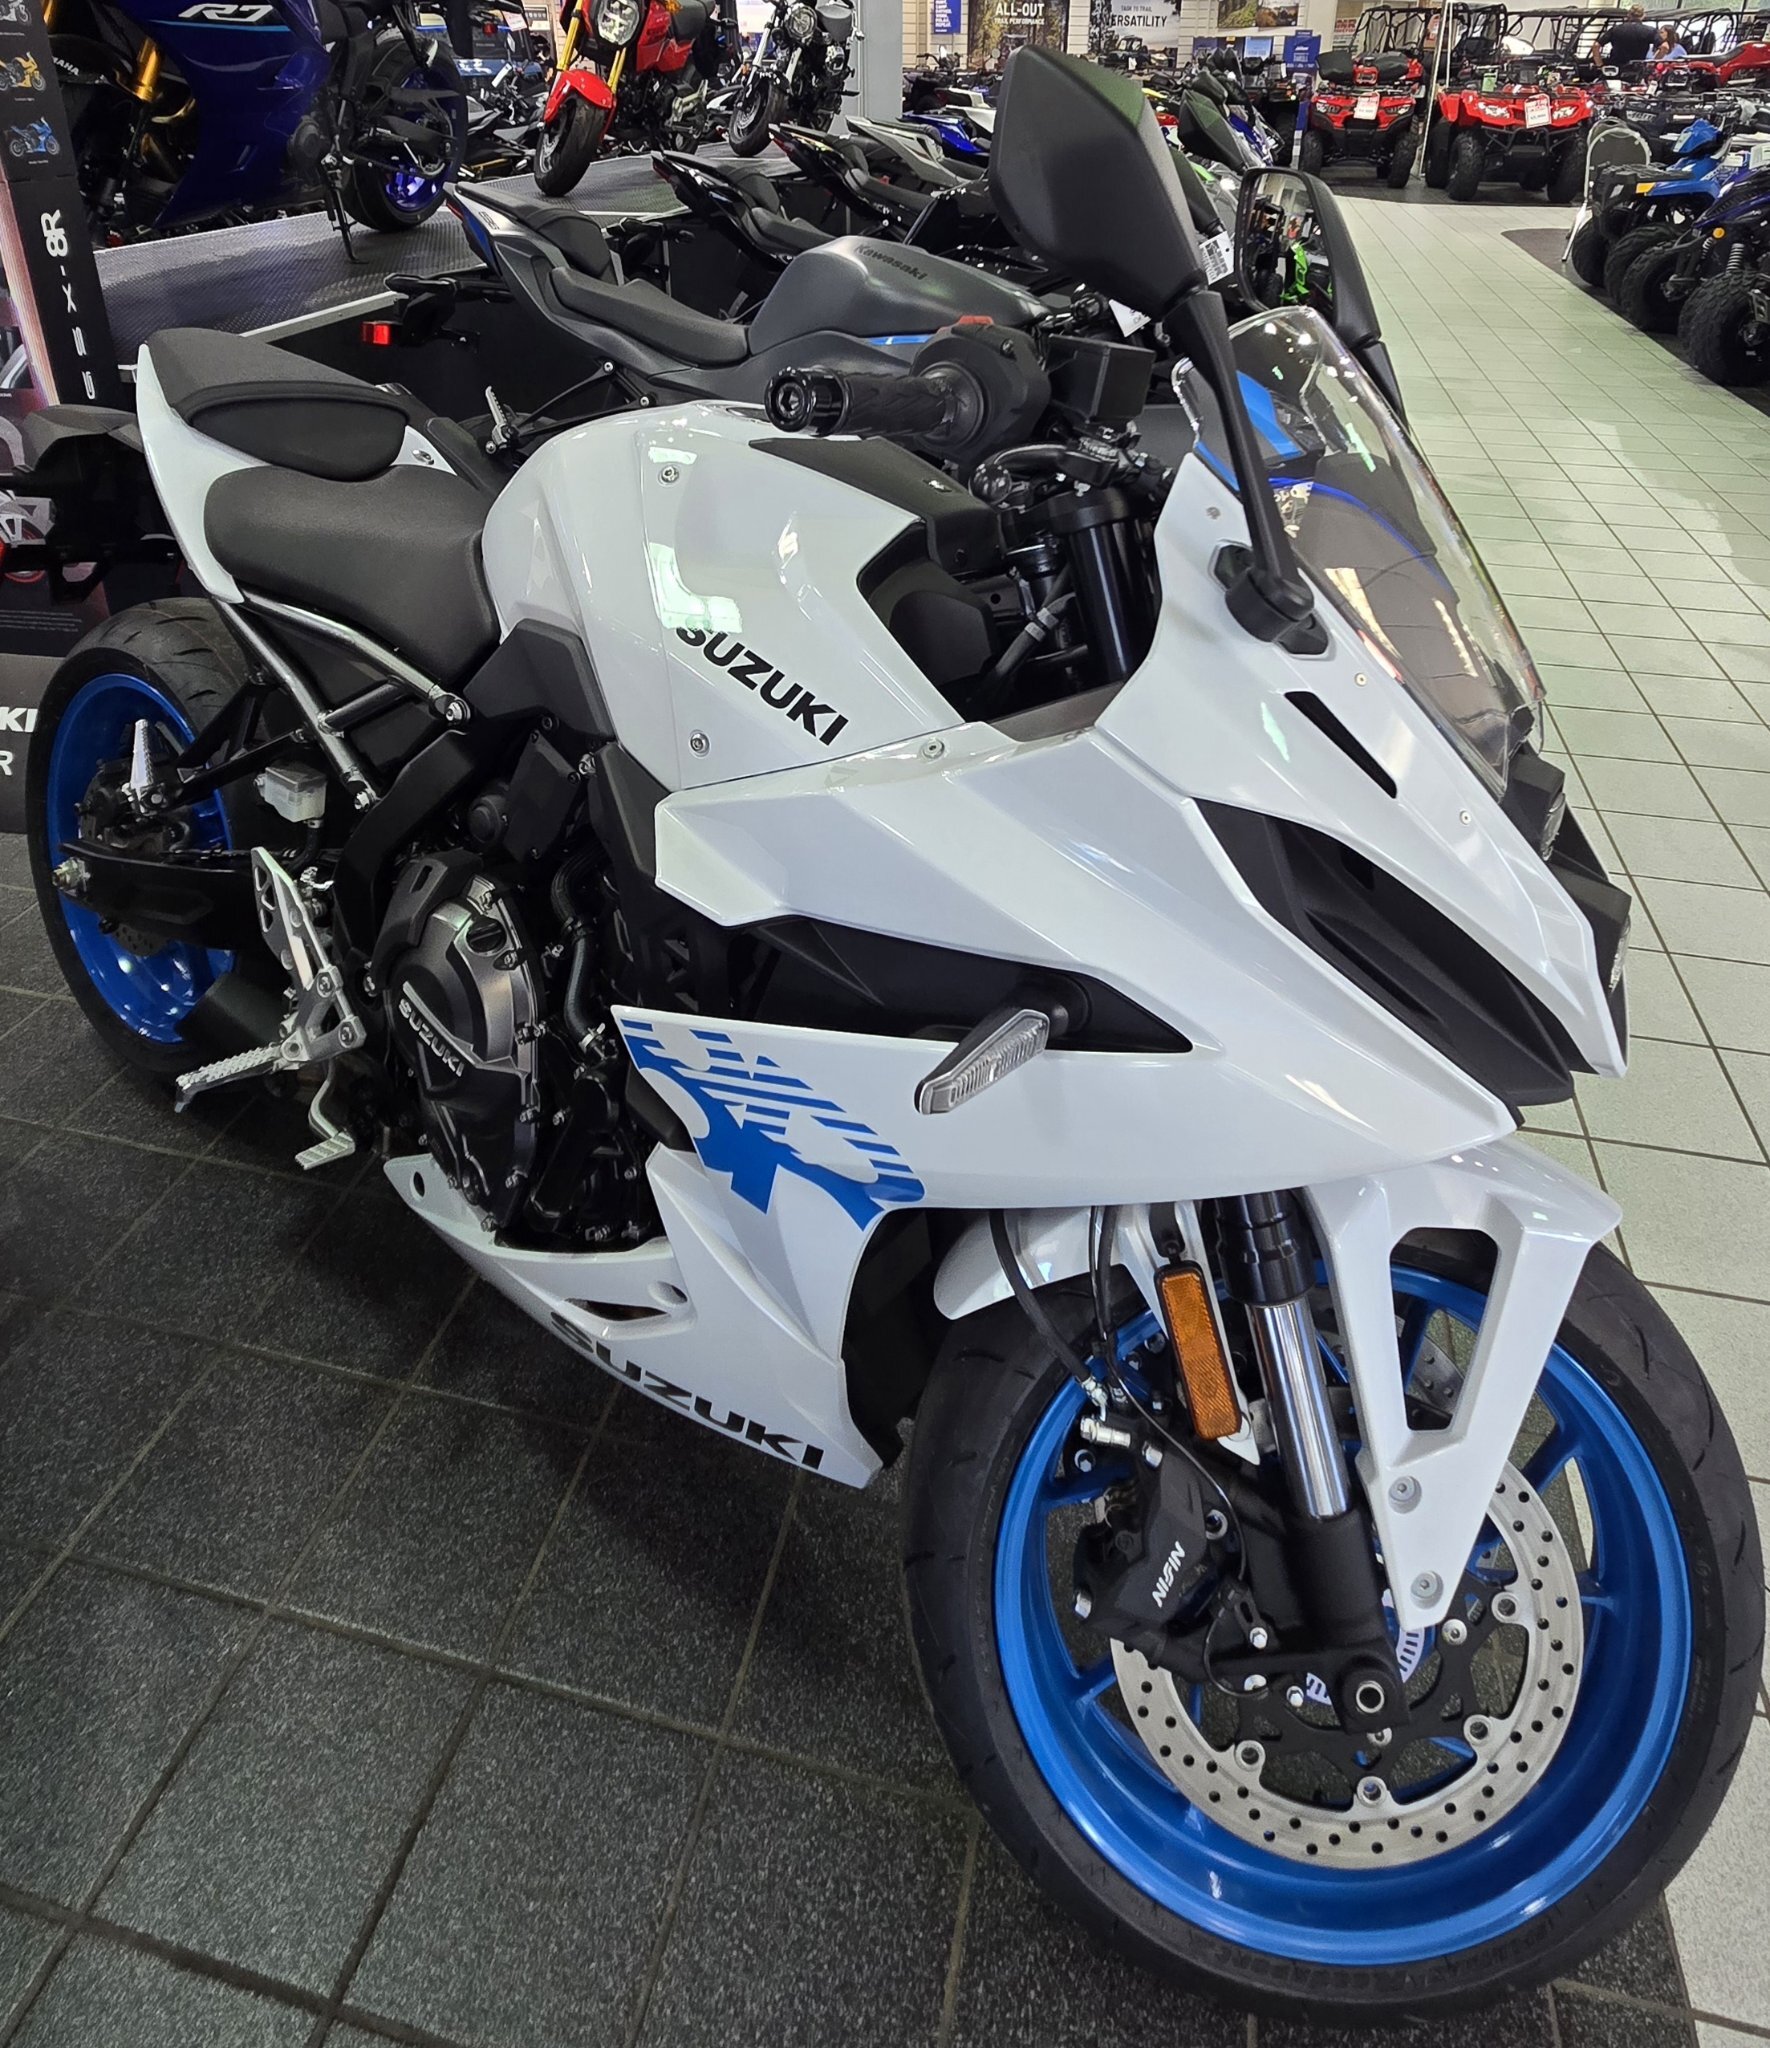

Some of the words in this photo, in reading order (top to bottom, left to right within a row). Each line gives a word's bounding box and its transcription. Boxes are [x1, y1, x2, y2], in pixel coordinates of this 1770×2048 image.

[178, 3, 274, 22] R7
[995, 3, 1045, 17] ALL-OUT
[1009, 18, 1045, 26] PERFORMANCE
[52, 56, 80, 77] MAHA
[854, 244, 928, 280] Kawasaki
[398, 998, 465, 1077] SUZUKI
[550, 1311, 824, 1470] SUZUKI
[1151, 1540, 1186, 1608] NISSIN
